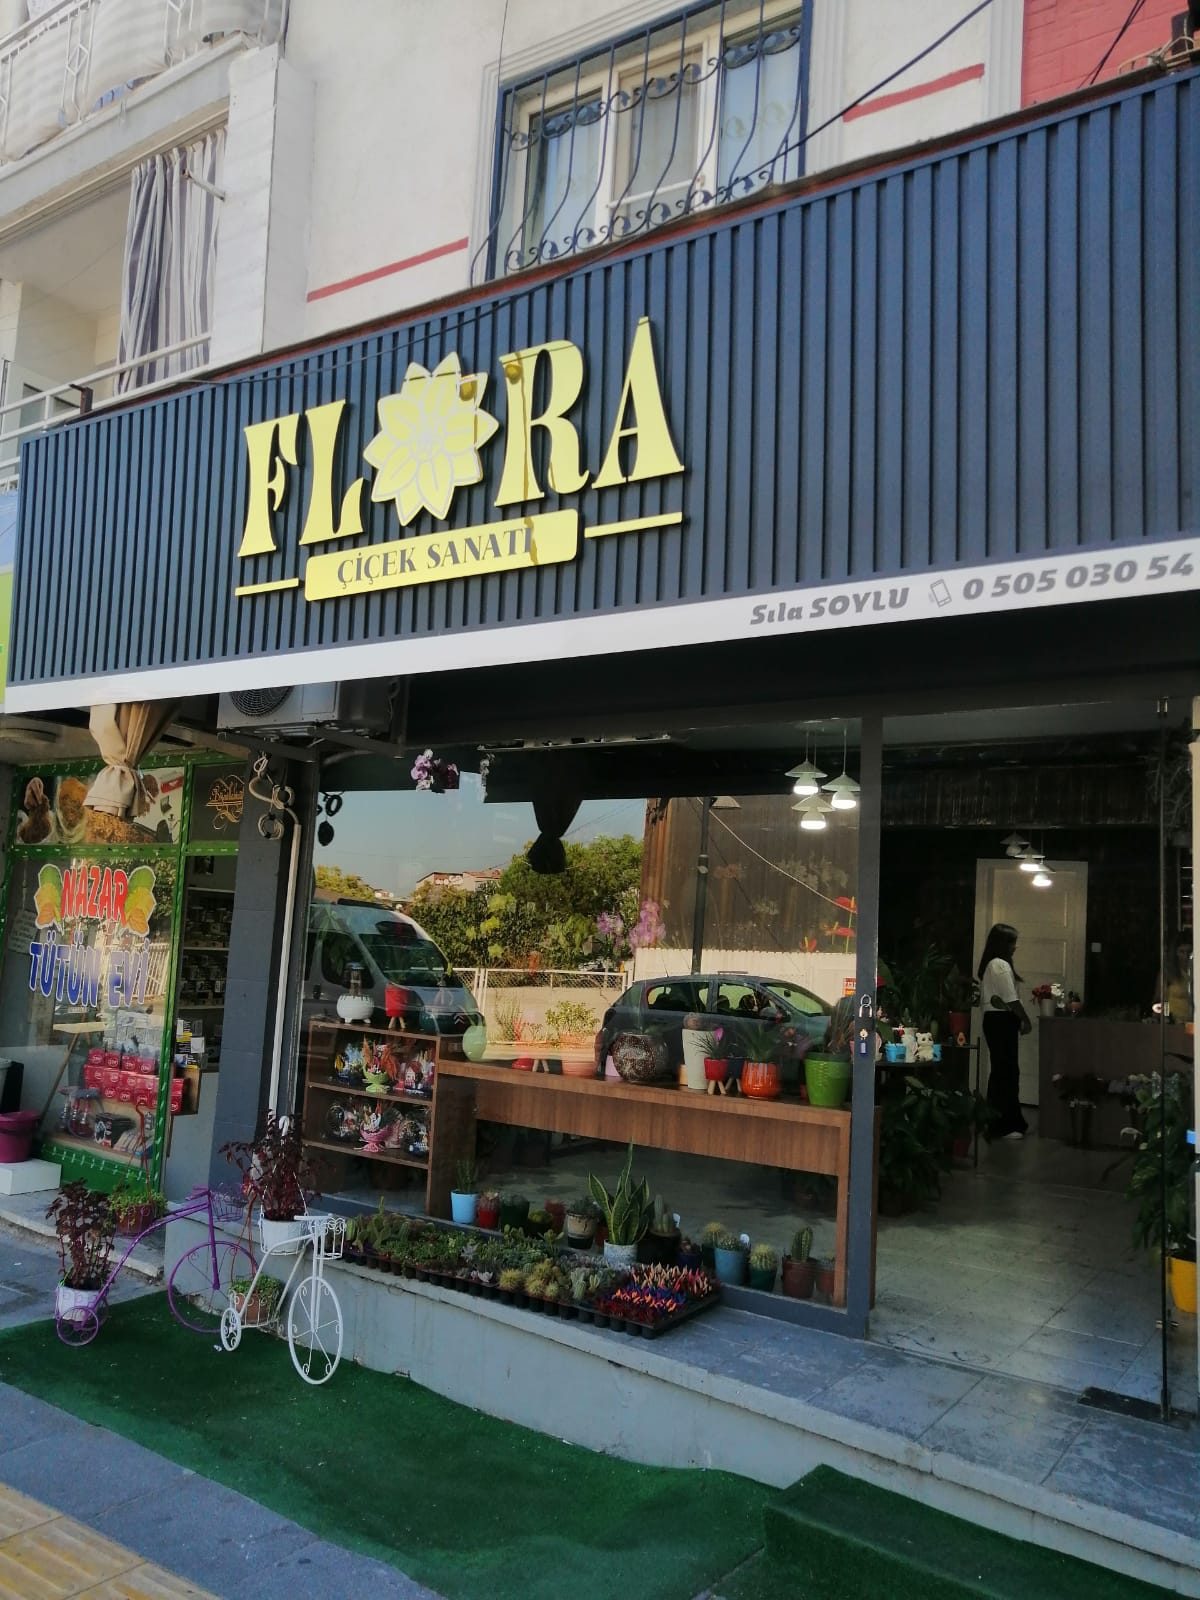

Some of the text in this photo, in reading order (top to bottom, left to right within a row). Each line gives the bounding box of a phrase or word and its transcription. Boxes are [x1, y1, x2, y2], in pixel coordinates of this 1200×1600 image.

[337, 527, 533, 590] ÇİÇEK SANATI
[750, 553, 1194, 625] Sıla SOYLU 0 505 030 54
[61, 865, 129, 928] NAZAR
[29, 930, 101, 1008] TÜTÜN
[108, 938, 150, 1008] EVİ
